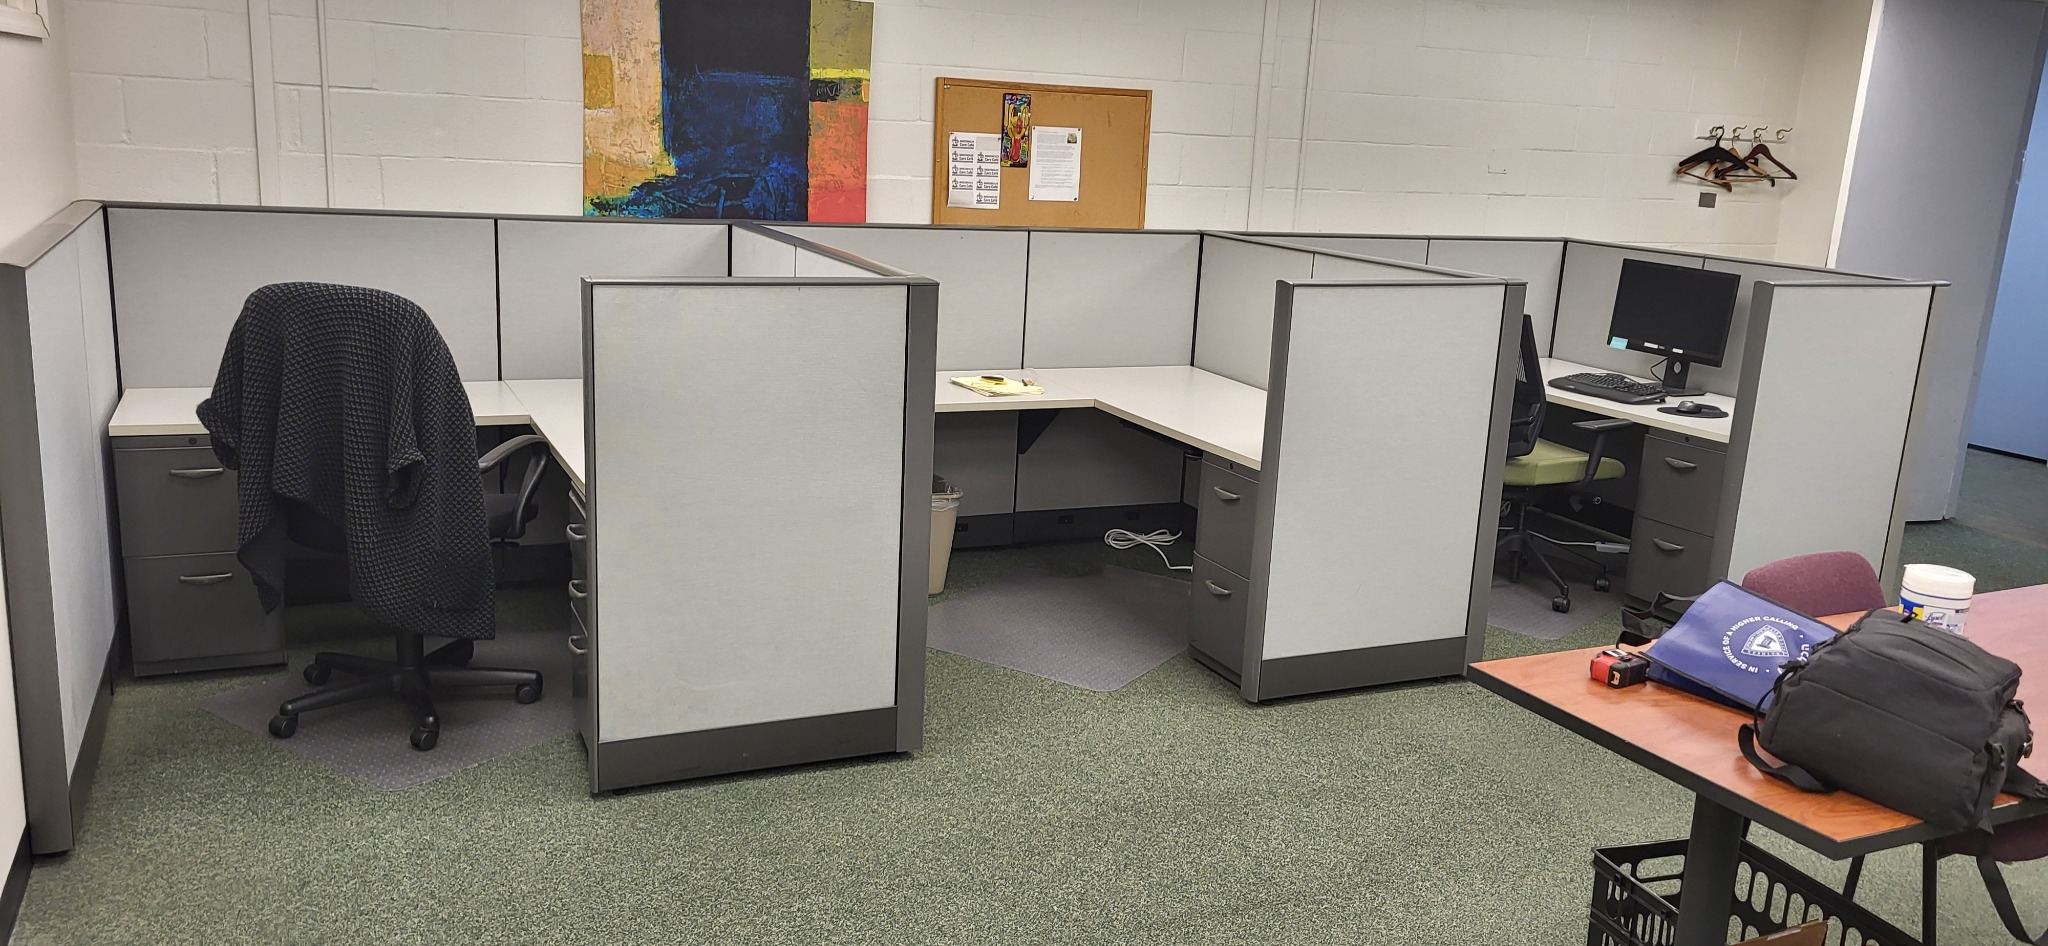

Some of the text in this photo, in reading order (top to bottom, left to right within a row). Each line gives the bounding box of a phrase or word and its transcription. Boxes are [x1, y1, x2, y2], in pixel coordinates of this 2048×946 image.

[1730, 616, 1761, 631] HIGHER
[1763, 616, 1799, 631] CALLING
[1722, 636, 1730, 645] OF
[1723, 646, 1747, 670] SERVICE
